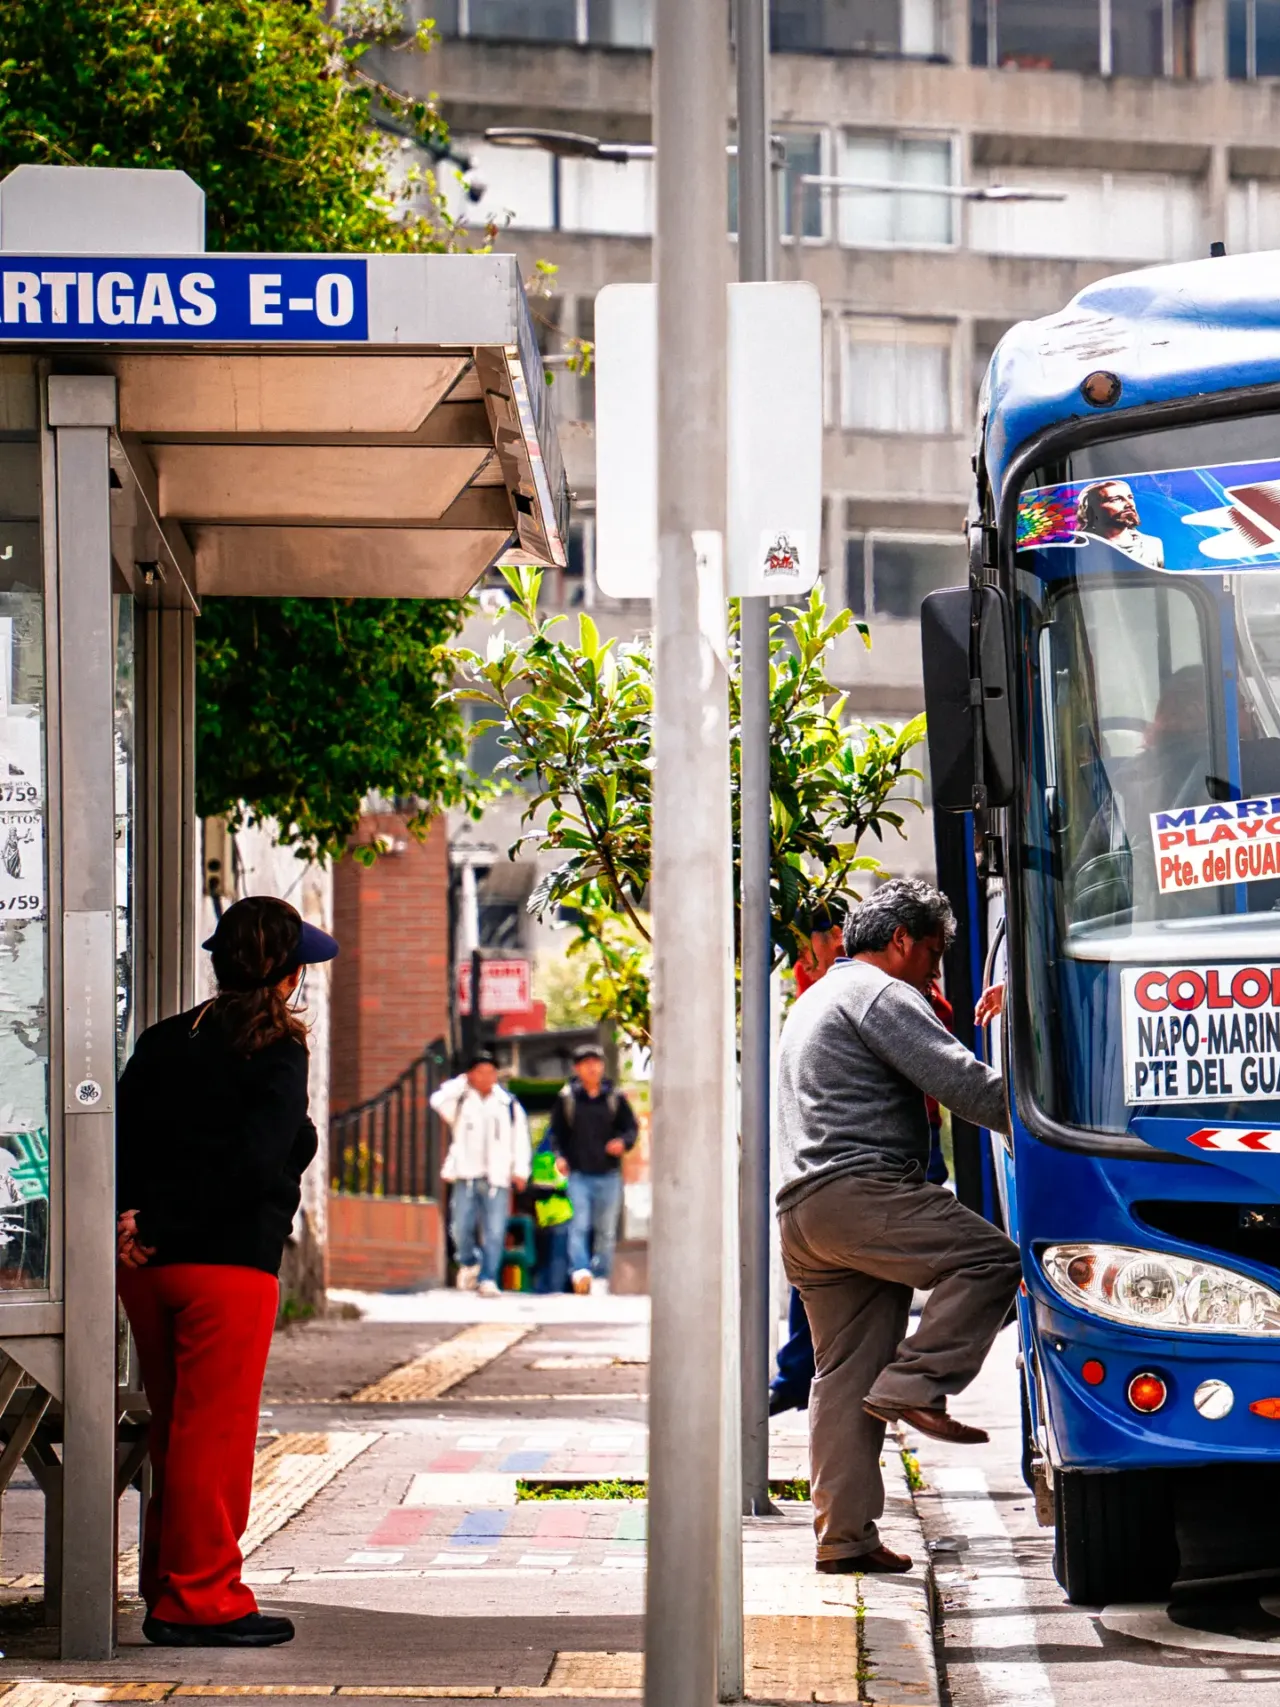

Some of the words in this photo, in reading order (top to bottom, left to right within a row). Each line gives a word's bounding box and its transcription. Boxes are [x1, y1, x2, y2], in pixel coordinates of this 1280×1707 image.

[0, 271, 217, 326] RTIGAS
[1160, 854, 1199, 889] Pte.
[1203, 847, 1231, 882] del
[1134, 1060, 1179, 1097] PTE
[1187, 1058, 1233, 1095] DEL
